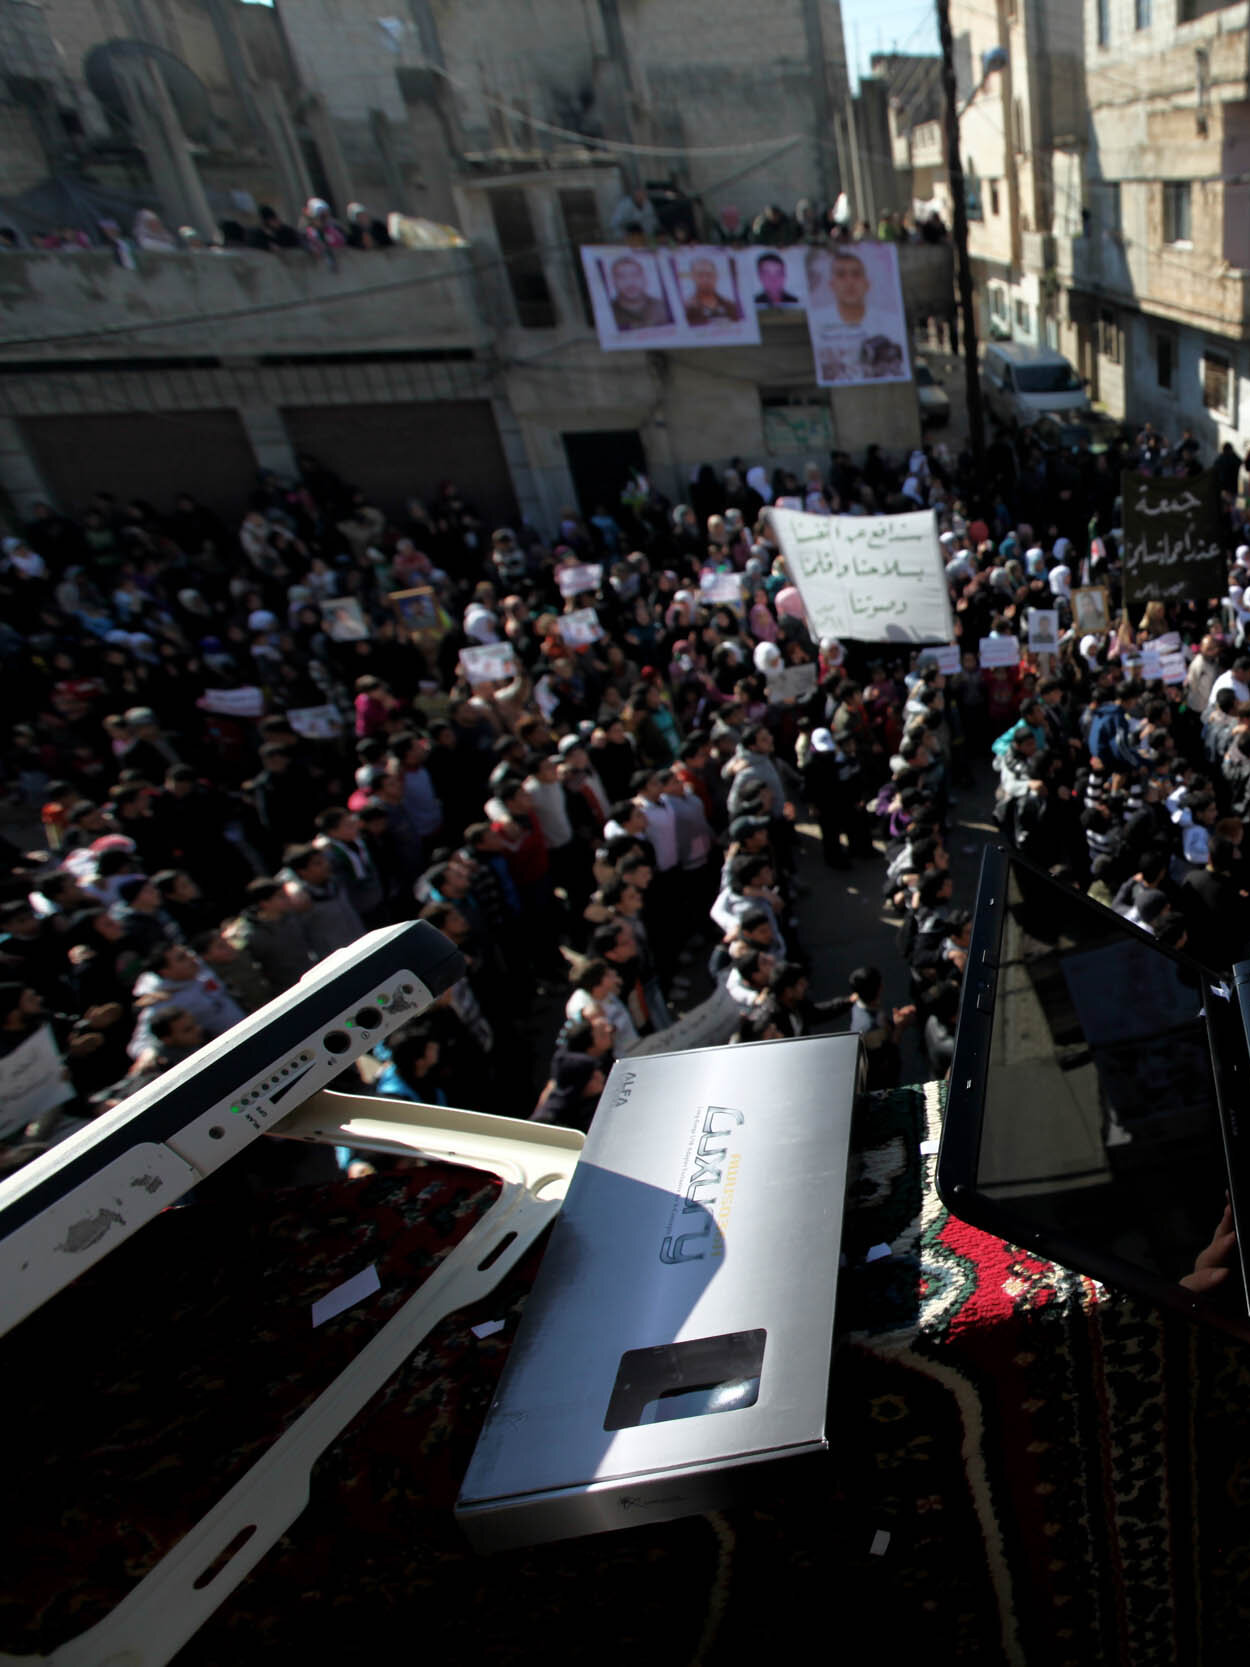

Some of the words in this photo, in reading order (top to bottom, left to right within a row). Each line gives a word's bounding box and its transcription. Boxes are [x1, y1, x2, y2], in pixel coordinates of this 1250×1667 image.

[1134, 484, 1201, 518] جمعة
[616, 1072, 636, 1107] ALFA
[659, 1106, 744, 1265] Luxury
